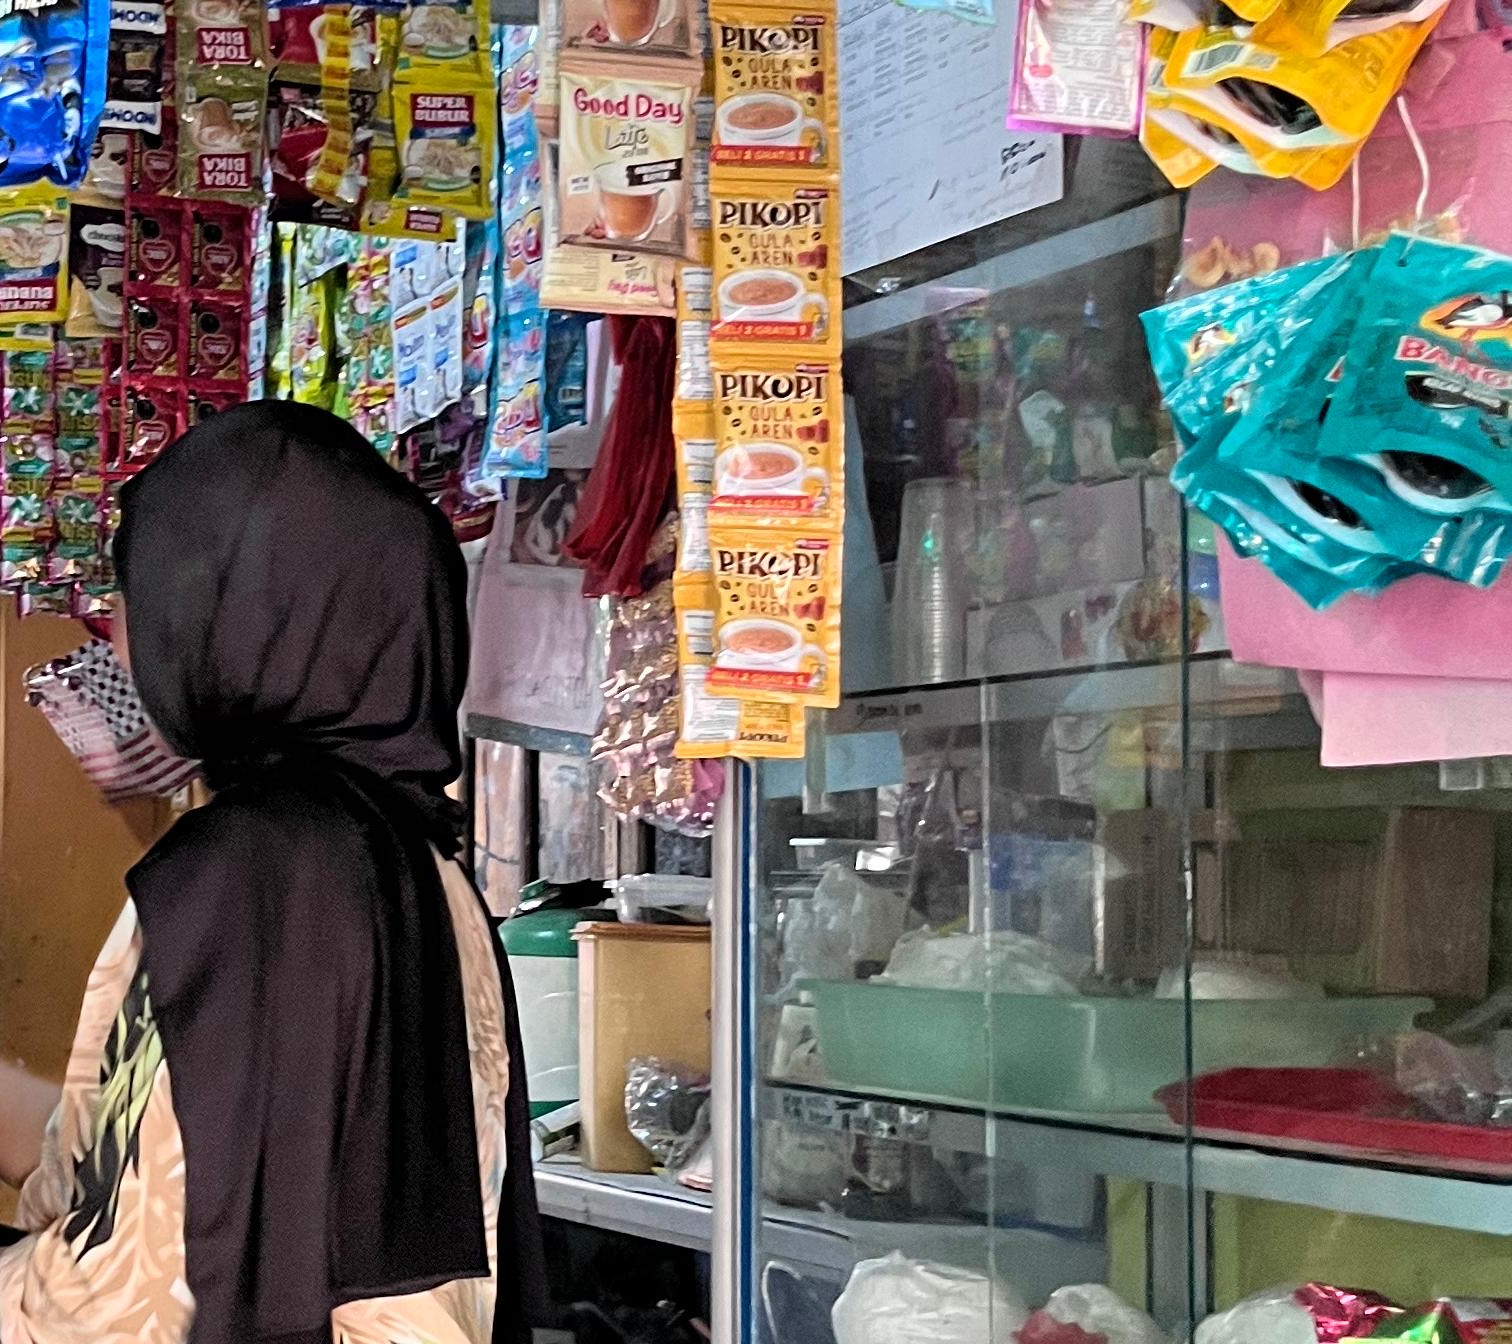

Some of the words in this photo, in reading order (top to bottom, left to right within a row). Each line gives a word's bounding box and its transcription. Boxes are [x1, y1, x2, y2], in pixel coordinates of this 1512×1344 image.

[201, 30, 243, 46] BIKA
[721, 26, 820, 54] PIKOPI
[204, 45, 249, 61] TORA
[574, 88, 629, 118] Good
[635, 93, 684, 123] Day
[201, 156, 243, 172] BIKA
[204, 172, 249, 187] TORA
[718, 200, 822, 228] PIKOPI
[719, 374, 824, 402] PIKOPI
